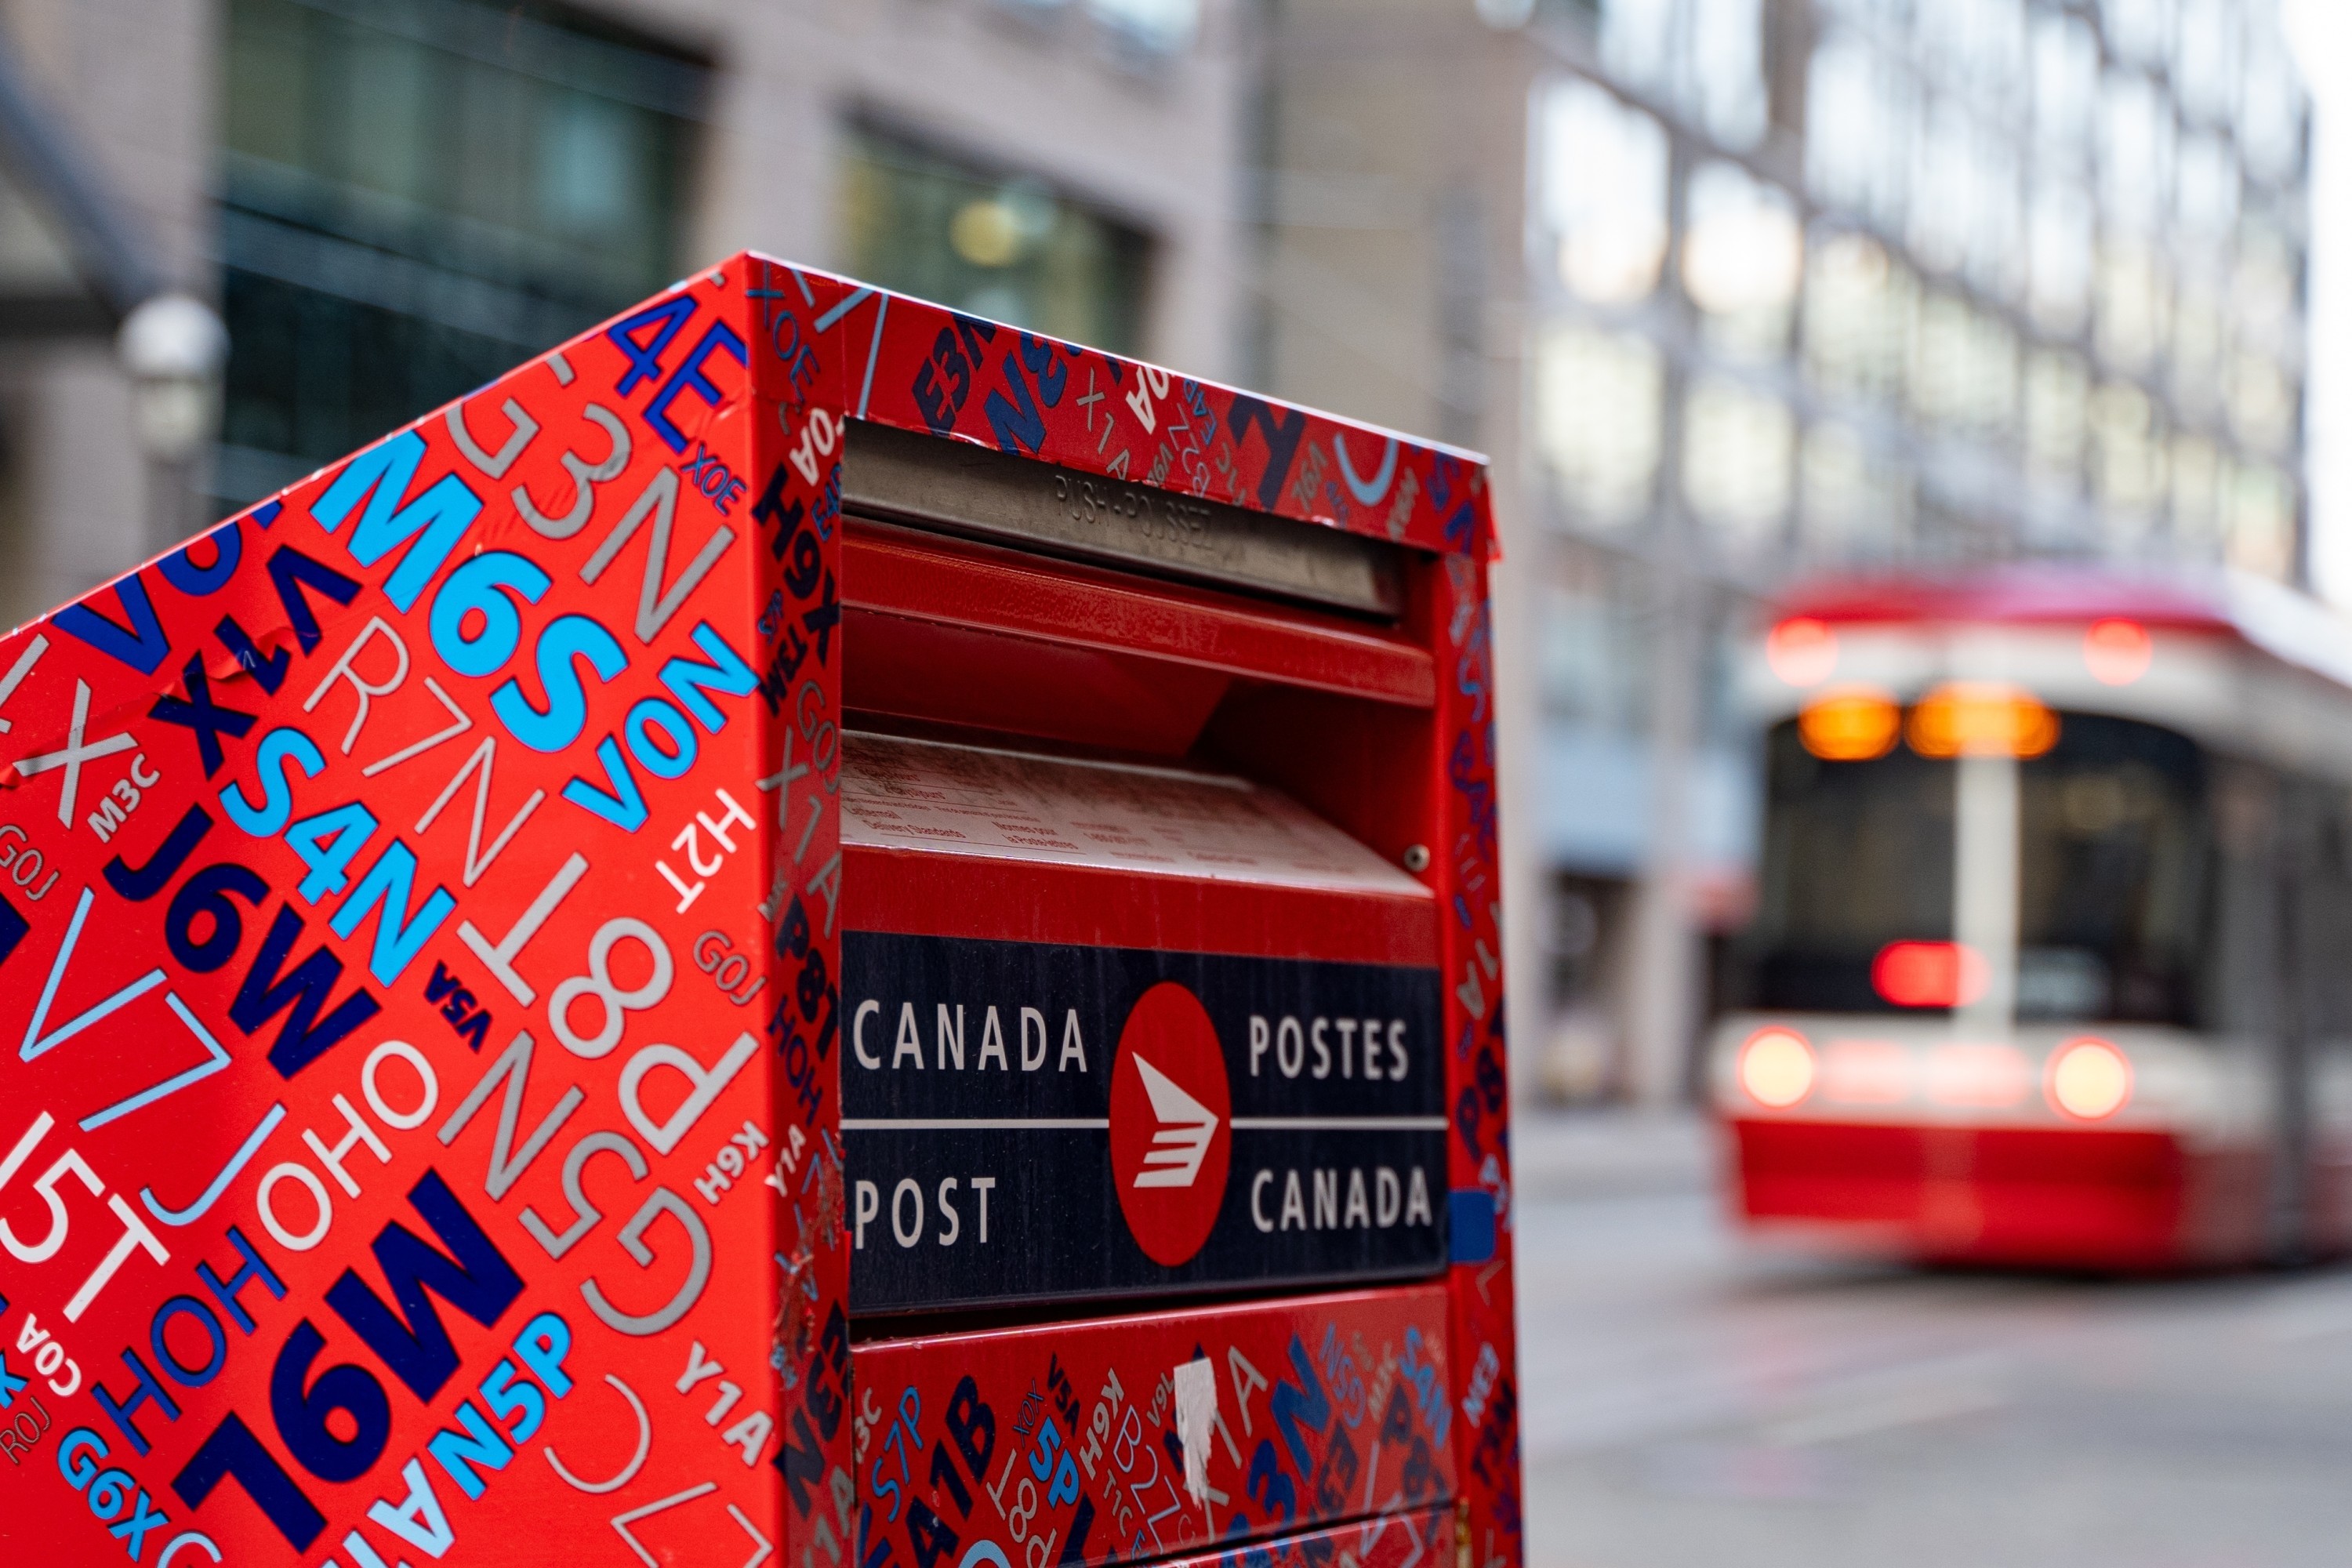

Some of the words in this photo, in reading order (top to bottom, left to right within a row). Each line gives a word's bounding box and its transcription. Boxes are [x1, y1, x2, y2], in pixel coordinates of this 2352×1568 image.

[307, 428, 632, 754] M6S
[86, 752, 161, 844] M3C
[303, 615, 547, 888] R7N
[218, 725, 458, 989] S4N
[654, 787, 757, 915] H2T
[102, 801, 383, 1081] J6W
[456, 851, 760, 1157] P8T
[19, 884, 288, 1226] V7J
[424, 958, 493, 1054] V5A
[852, 999, 1087, 1073] CANADA
[1250, 1014, 1410, 1082] POSTES
[436, 1028, 713, 1336] G5N
[694, 1120, 770, 1206] K6H
[855, 1177, 996, 1250] POST
[1250, 1165, 1433, 1233] CANADA
[16, 1312, 82, 1397] C0A
[427, 1312, 574, 1501] N5P
[676, 1340, 774, 1468] Y1A
[1047, 1350, 1081, 1438] V5A
[854, 1385, 883, 1465] 3C
[871, 1385, 924, 1523] S7P
[906, 1374, 996, 1568] A1B
[1079, 1367, 1124, 1481] K6H
[1112, 1404, 1181, 1555] B2Z
[57, 1426, 171, 1563] G6X
